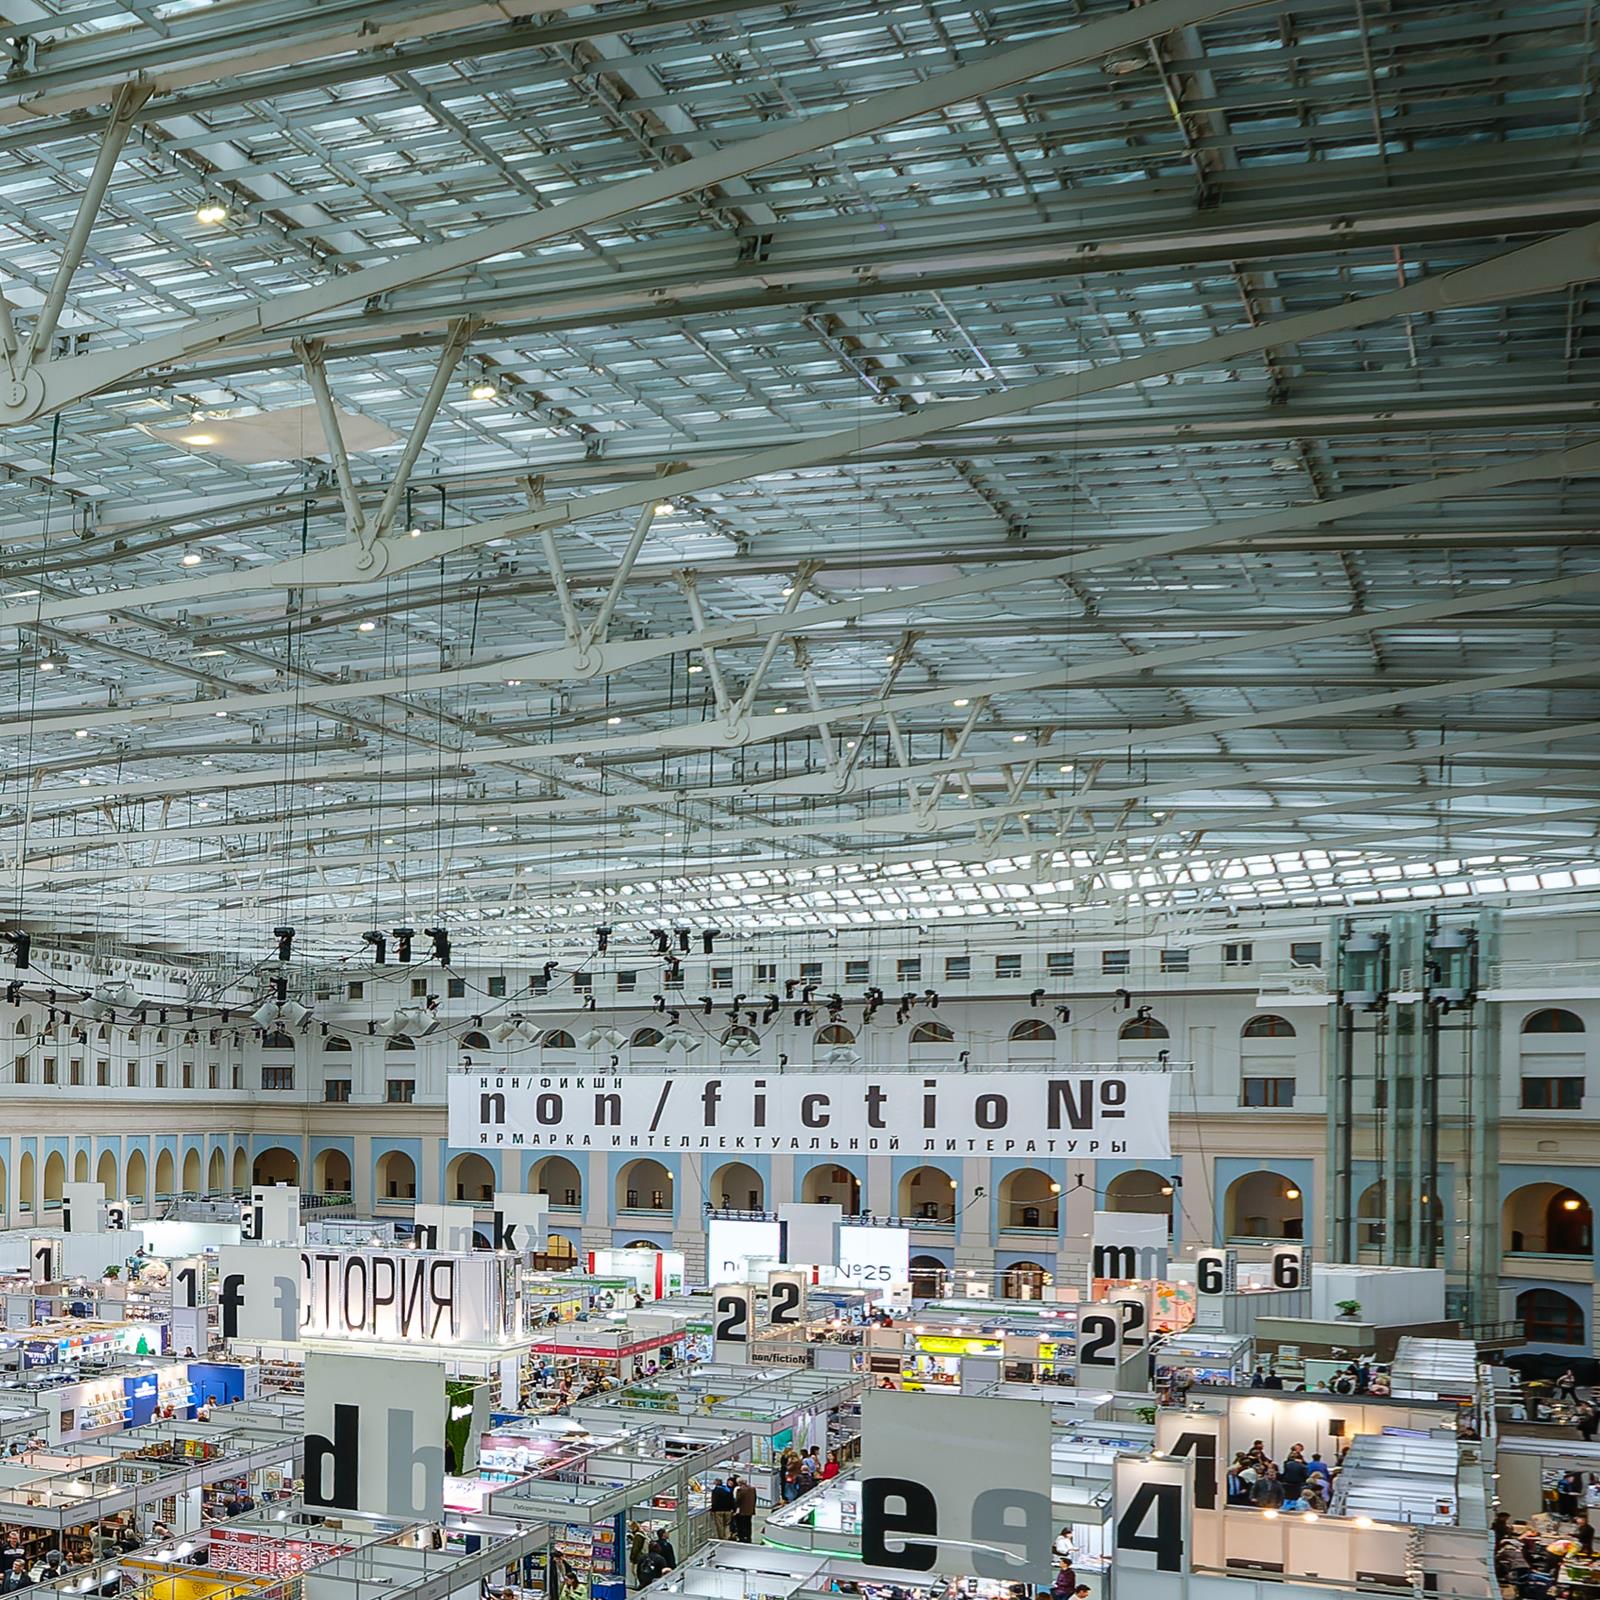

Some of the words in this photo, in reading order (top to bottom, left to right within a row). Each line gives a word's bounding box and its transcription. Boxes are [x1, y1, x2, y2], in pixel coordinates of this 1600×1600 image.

[480, 1077, 623, 1089] НОН/ФИКШН
[480, 1133, 591, 1145] ЯРМАРКА
[612, 1135, 899, 1151] ИНТЕЛЛЕКТУАЛЬНОЙ
[924, 1138, 1127, 1153] ЛИТЕРАТУРЫ
[108, 1208, 123, 1230] 3
[35, 1247, 52, 1282] 1
[1094, 1245, 1135, 1279] m
[1198, 1257, 1223, 1294] 6
[1274, 1253, 1299, 1289] 6
[176, 1268, 196, 1307] 1
[219, 1274, 244, 1338] f
[771, 1282, 800, 1324] 2
[717, 1296, 747, 1341] 2
[1120, 1300, 1146, 1346] 2
[751, 1352, 806, 1364] non/fictioN
[1081, 1315, 1116, 1366] 2
[304, 1404, 359, 1510] d
[1169, 1432, 1218, 1509] 4
[861, 1478, 937, 1572] e
[1117, 1482, 1183, 1573] 4
